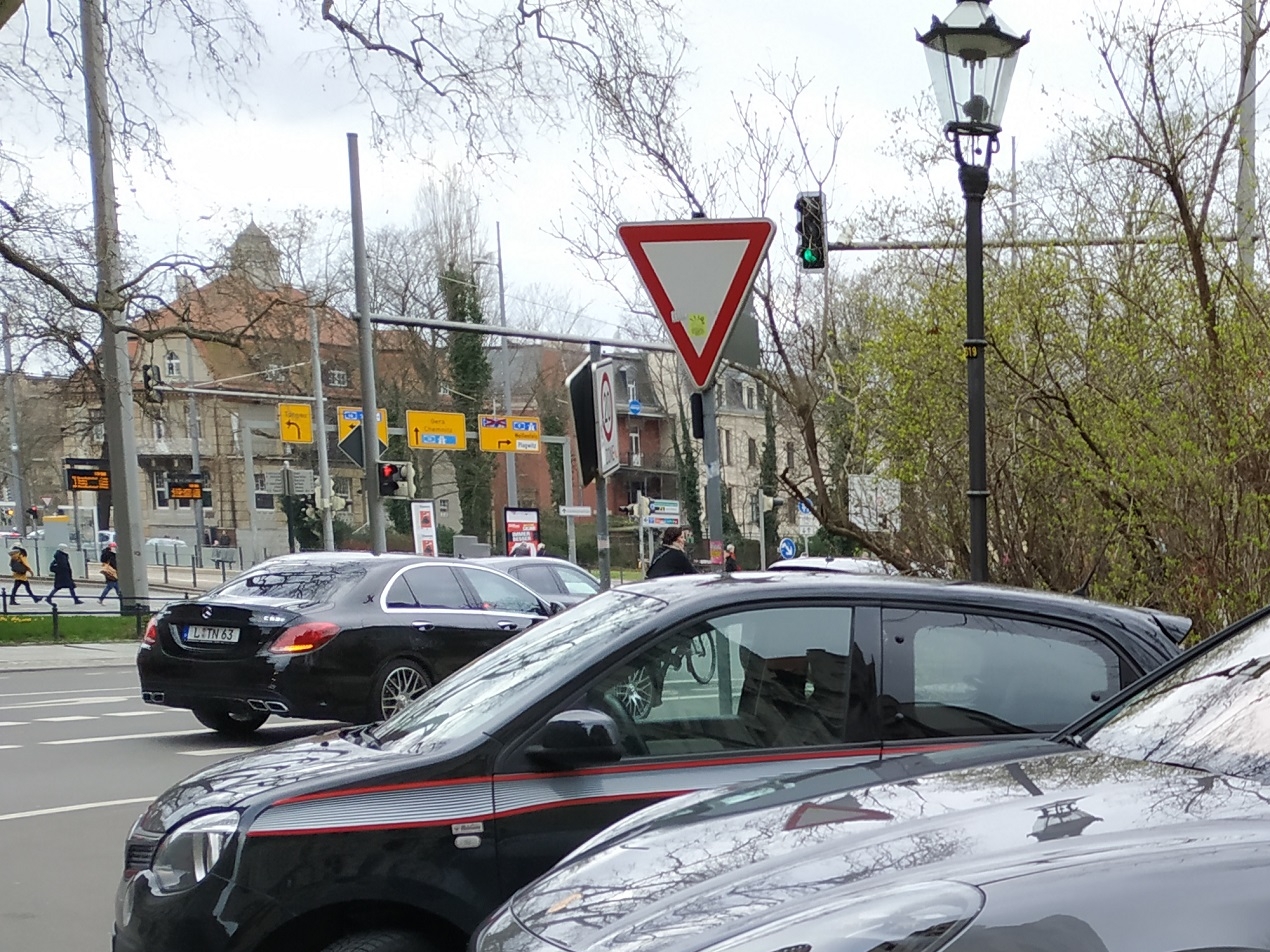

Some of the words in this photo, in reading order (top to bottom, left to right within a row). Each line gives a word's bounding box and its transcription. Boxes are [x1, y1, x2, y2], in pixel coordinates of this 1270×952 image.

[193, 626, 200, 639] L
[207, 627, 220, 640] TN
[221, 628, 234, 641] 63
